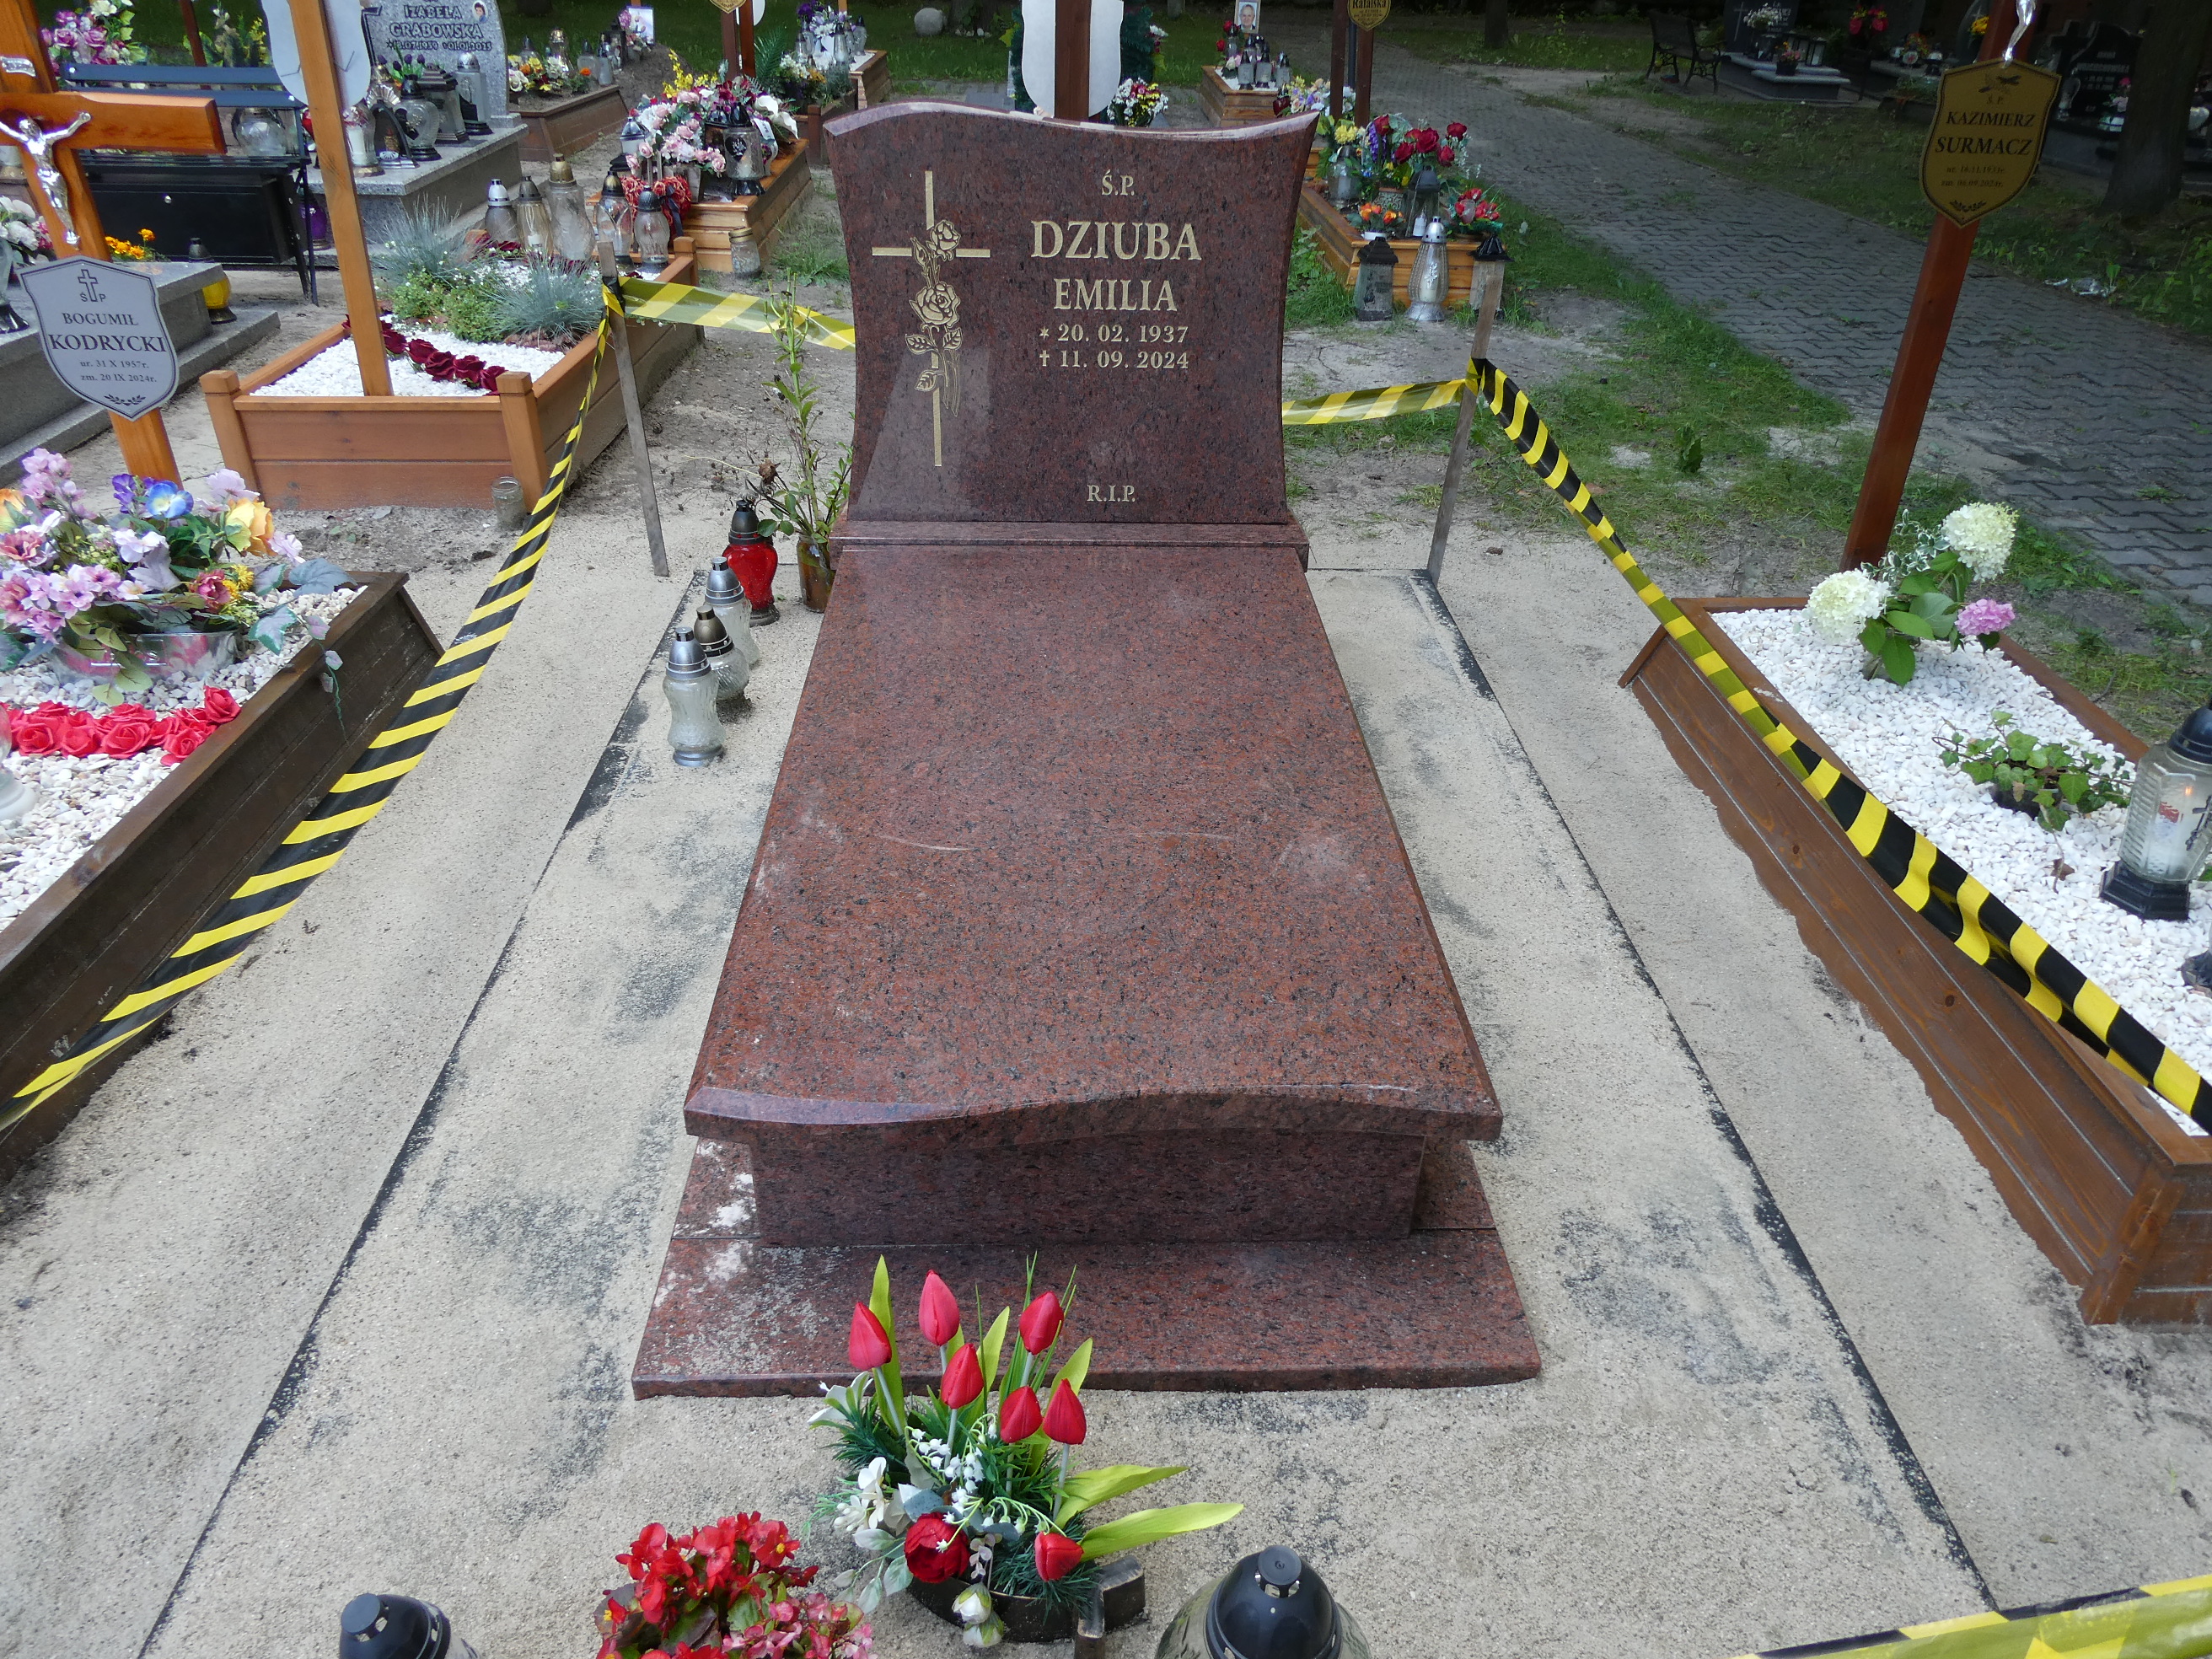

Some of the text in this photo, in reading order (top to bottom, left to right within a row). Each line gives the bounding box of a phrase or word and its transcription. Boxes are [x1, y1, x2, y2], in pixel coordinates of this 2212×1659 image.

[404, 5, 463, 19] IZABELA
[389, 22, 484, 39] GRABOWSKA
[1946, 111, 2036, 127] KAZIMIERZ
[1935, 136, 2033, 155] SURMACZ
[1101, 169, 1135, 196] Ś.P.
[1030, 220, 1202, 260] DZIUBA
[1053, 277, 1178, 312] EMILIA
[62, 312, 138, 326] BOGUMIŁ
[1057, 323, 1189, 343] 20. 02. 1937
[48, 334, 167, 352] KODRYCKI
[1060, 350, 1189, 369] 11. 09. 2024
[113, 373, 126, 382] IX
[1086, 484, 1136, 502] R.I.P.
